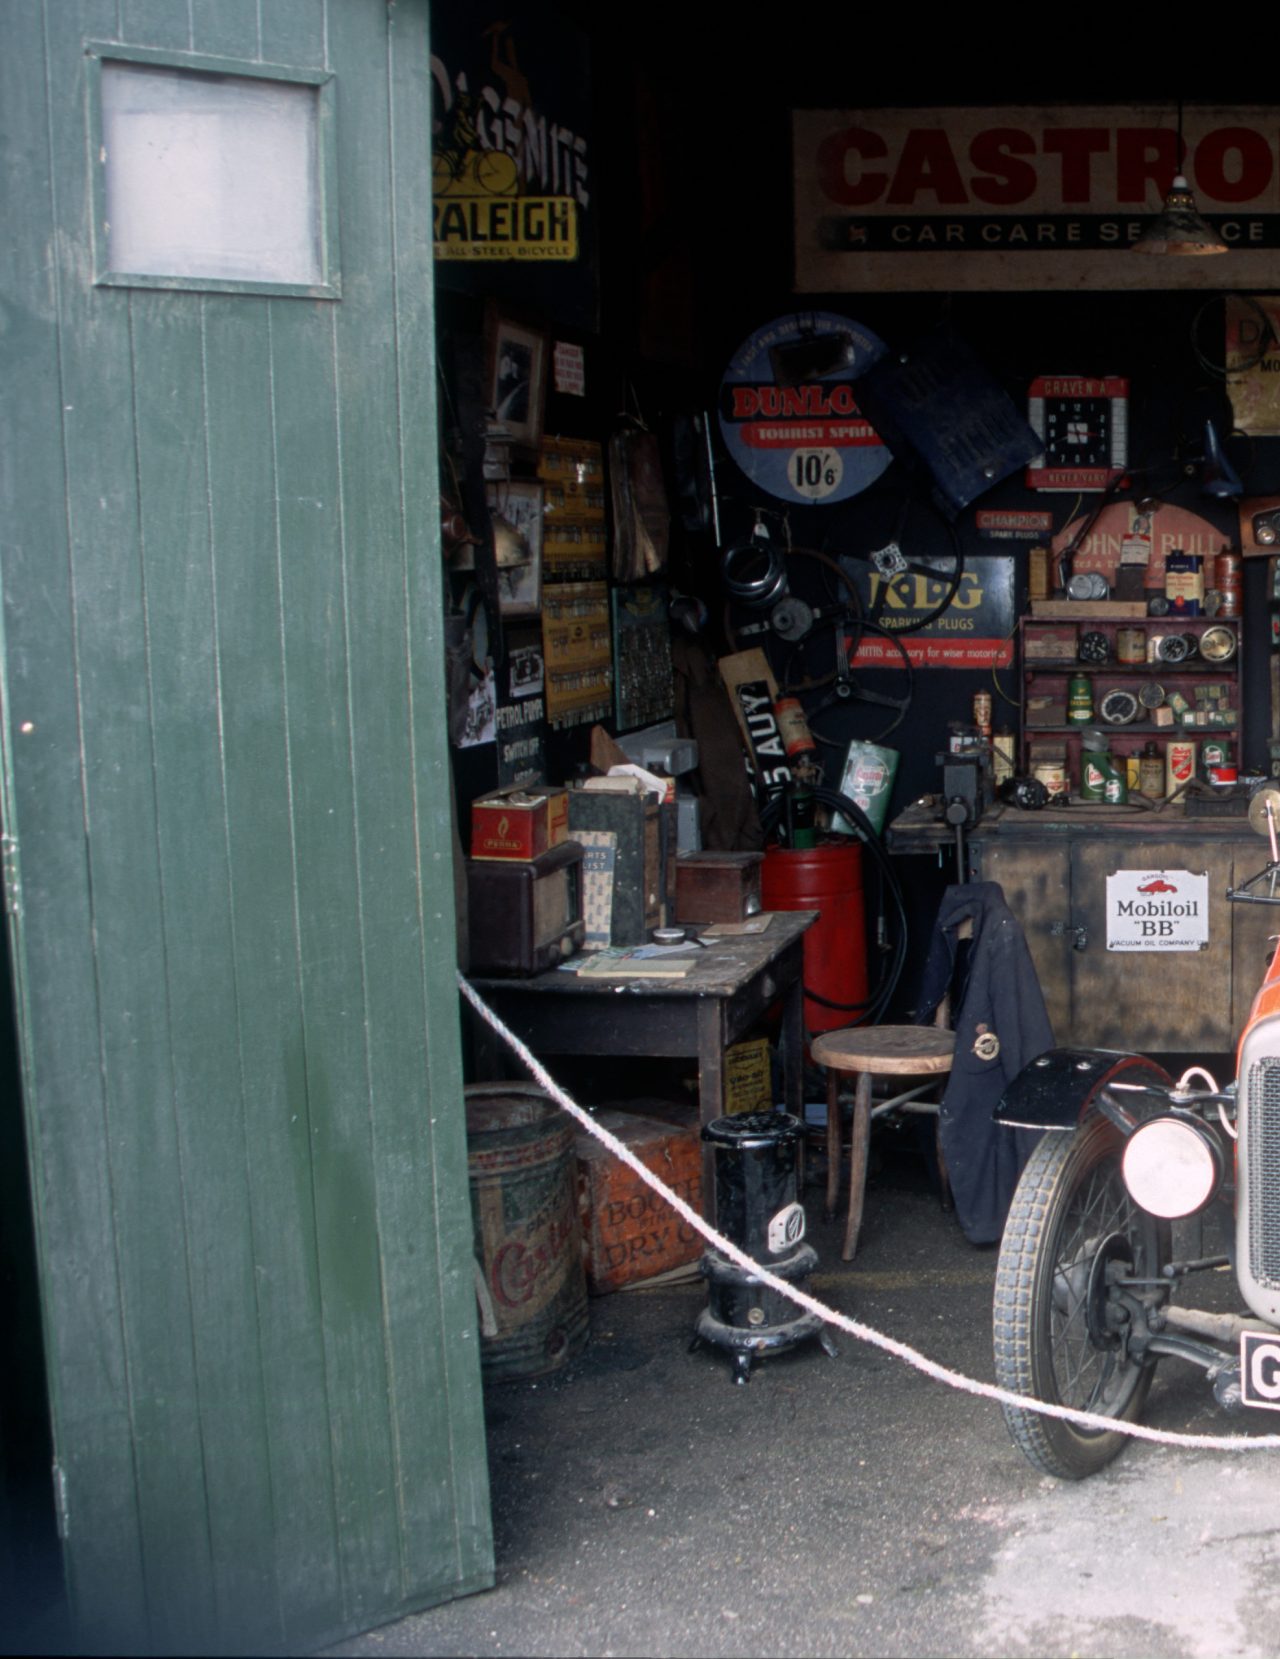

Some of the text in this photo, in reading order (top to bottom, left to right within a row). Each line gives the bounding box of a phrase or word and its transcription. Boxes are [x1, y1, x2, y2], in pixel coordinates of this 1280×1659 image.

[891, 222, 1265, 243] CAR CARE SECE
[1045, 380, 1093, 395] CRAVEN
[732, 385, 862, 418] DUNLO
[757, 426, 824, 442] TOURIST
[981, 513, 1049, 528] CHAMPION
[990, 531, 1039, 539] SPARK PLUGS
[1161, 533, 1220, 556] BULL
[937, 617, 974, 631] PLUGS
[927, 647, 940, 657] for
[943, 648, 965, 657] wiser
[1117, 900, 1199, 917] Mobiloil
